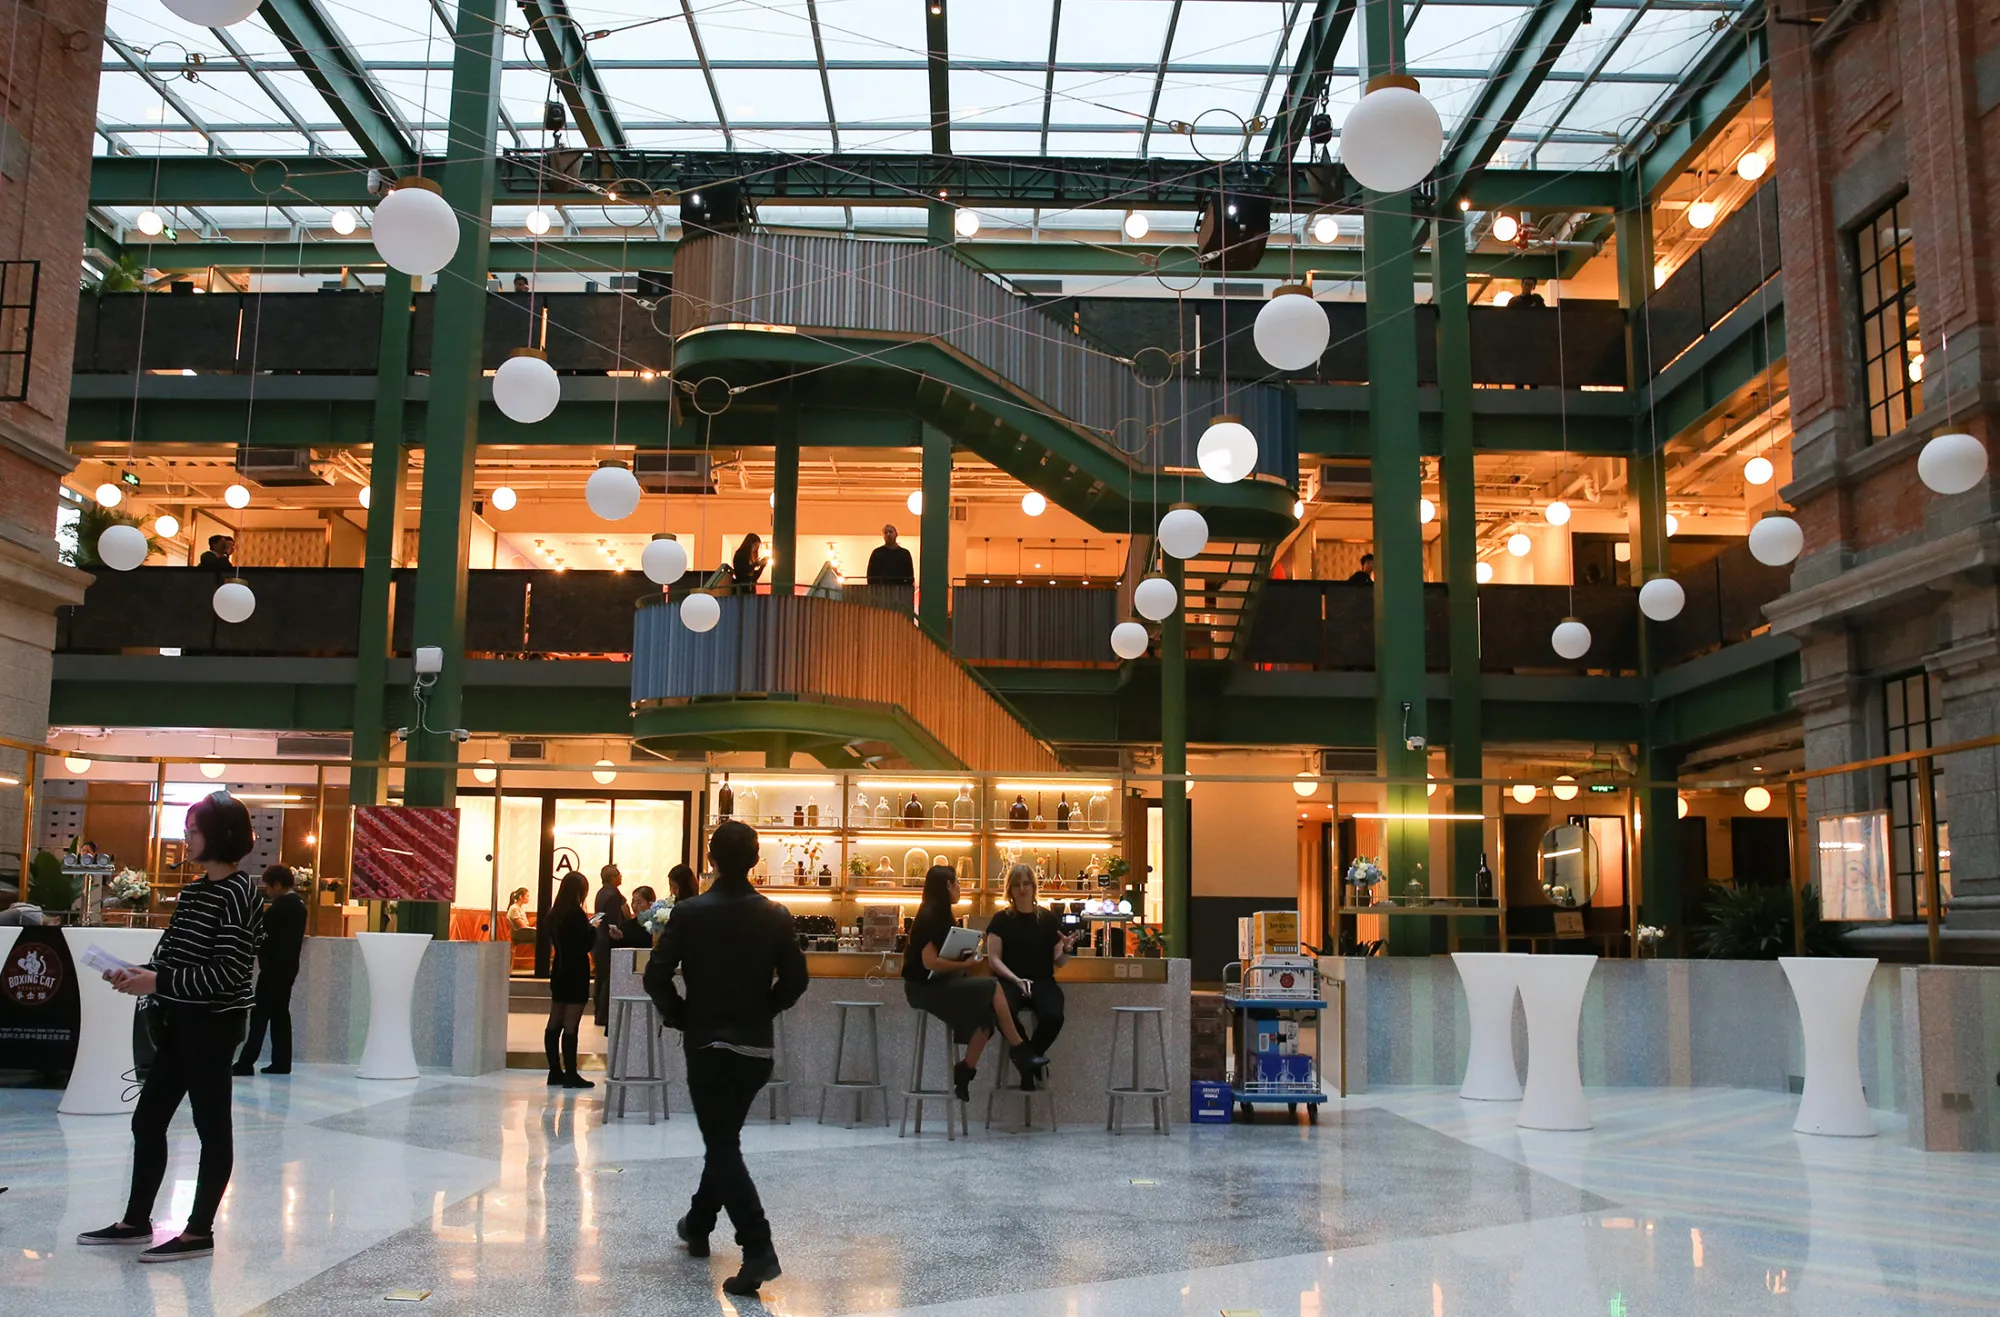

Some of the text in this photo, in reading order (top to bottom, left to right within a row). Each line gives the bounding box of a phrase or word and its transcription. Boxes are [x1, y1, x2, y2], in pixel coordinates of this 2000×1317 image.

[556, 854, 573, 872] A
[8, 974, 39, 989] BOXING
[39, 975, 56, 989] CAT
